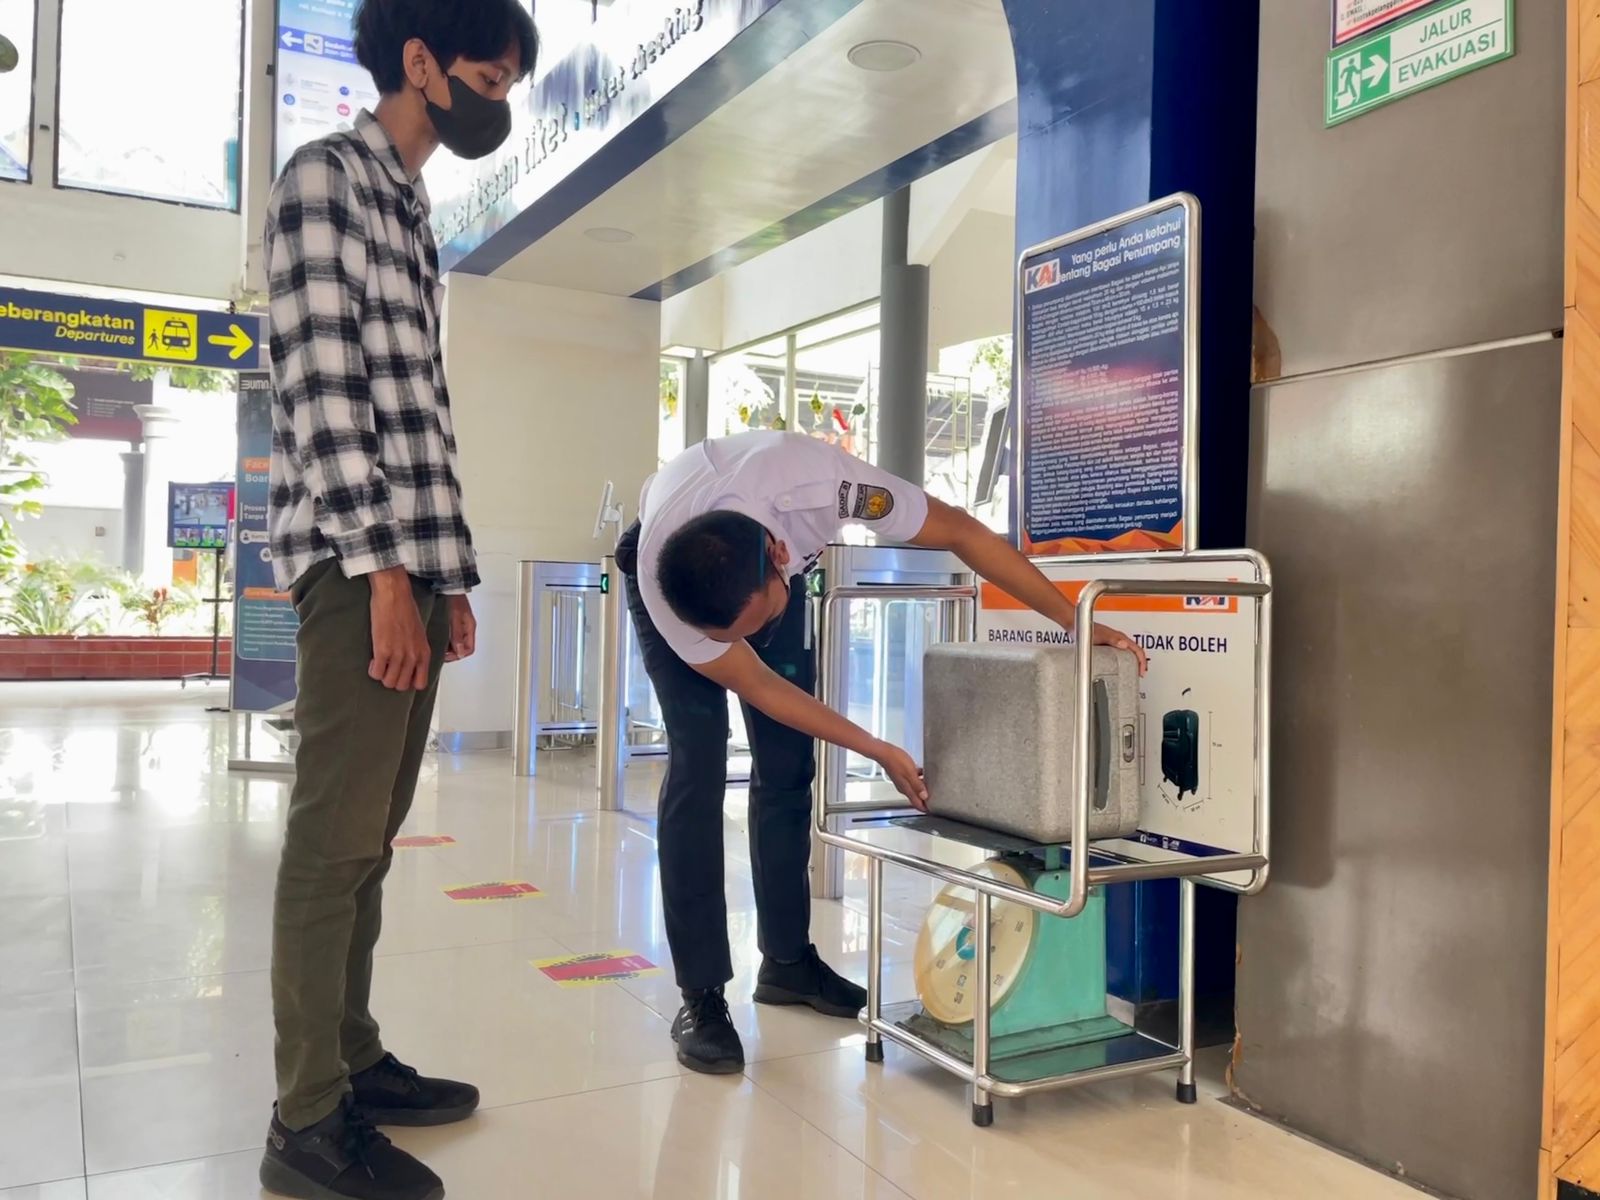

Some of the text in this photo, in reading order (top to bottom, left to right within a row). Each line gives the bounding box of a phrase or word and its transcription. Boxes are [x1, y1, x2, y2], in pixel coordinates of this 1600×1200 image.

[1420, 8, 1472, 43] JALUR
[1398, 30, 1496, 83] EVAKUASI
[1072, 220, 1182, 266] Yang perlu Anda ketahui
[1092, 254, 1122, 273] Bagasi
[1123, 235, 1181, 263] Penumpang
[1026, 263, 1059, 292] KAI
[55, 326, 136, 345] Departures
[988, 629, 1227, 653] BARANG BAWA TIDAK BOLEH
